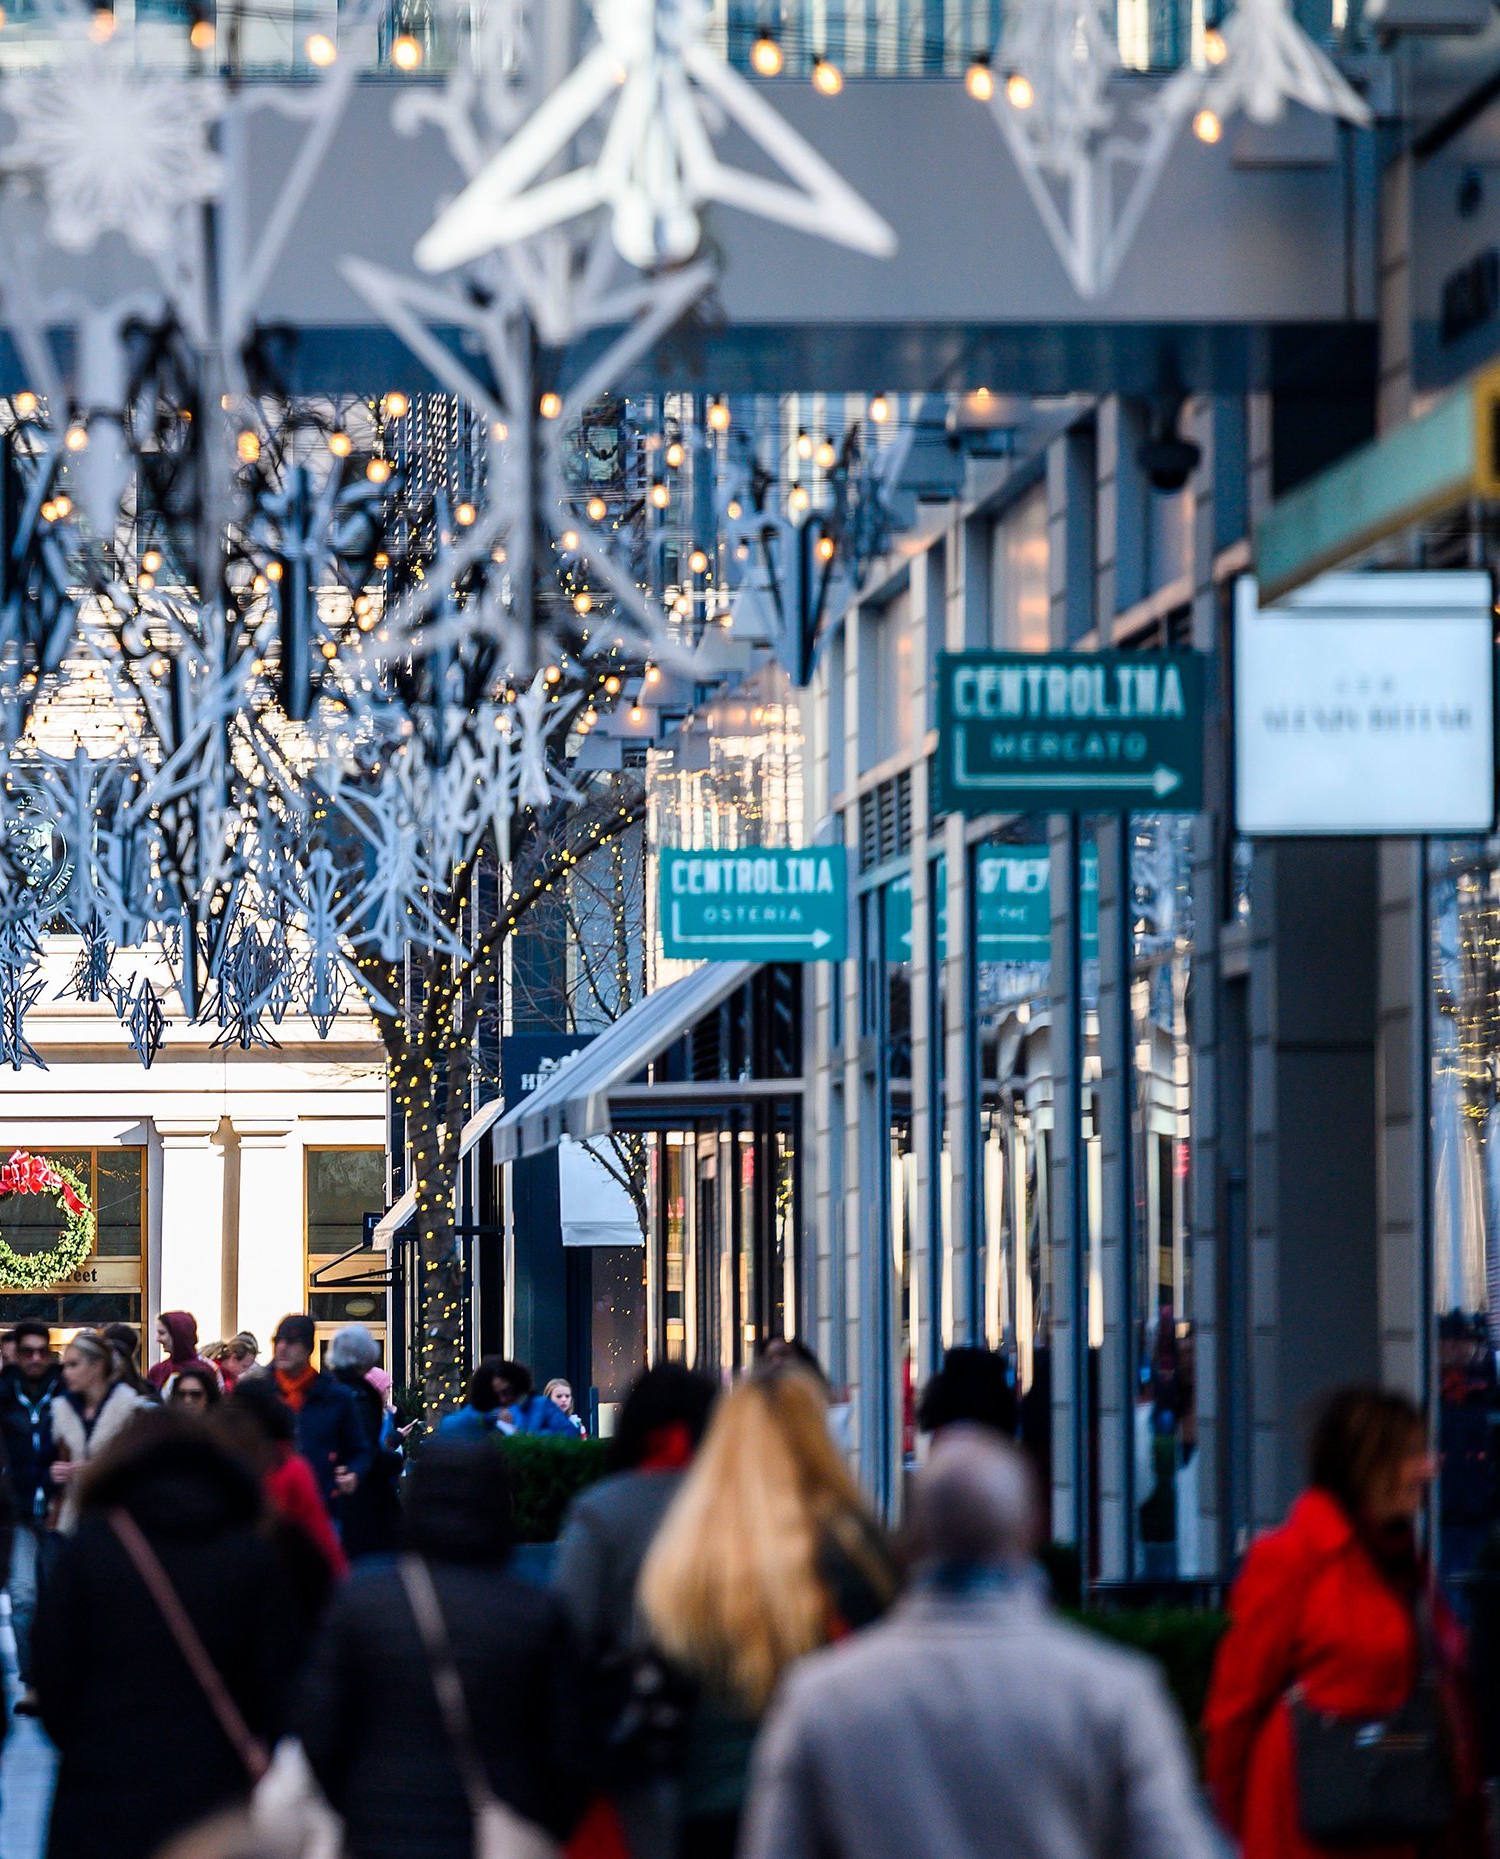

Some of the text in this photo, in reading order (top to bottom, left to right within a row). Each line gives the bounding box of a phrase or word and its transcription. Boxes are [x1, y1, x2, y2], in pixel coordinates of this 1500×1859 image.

[952, 663, 1185, 718] CENTROLINA
[990, 730, 1148, 763] MERCATO
[671, 857, 834, 894] CENTROLINA
[703, 905, 803, 925] OSTERIA
